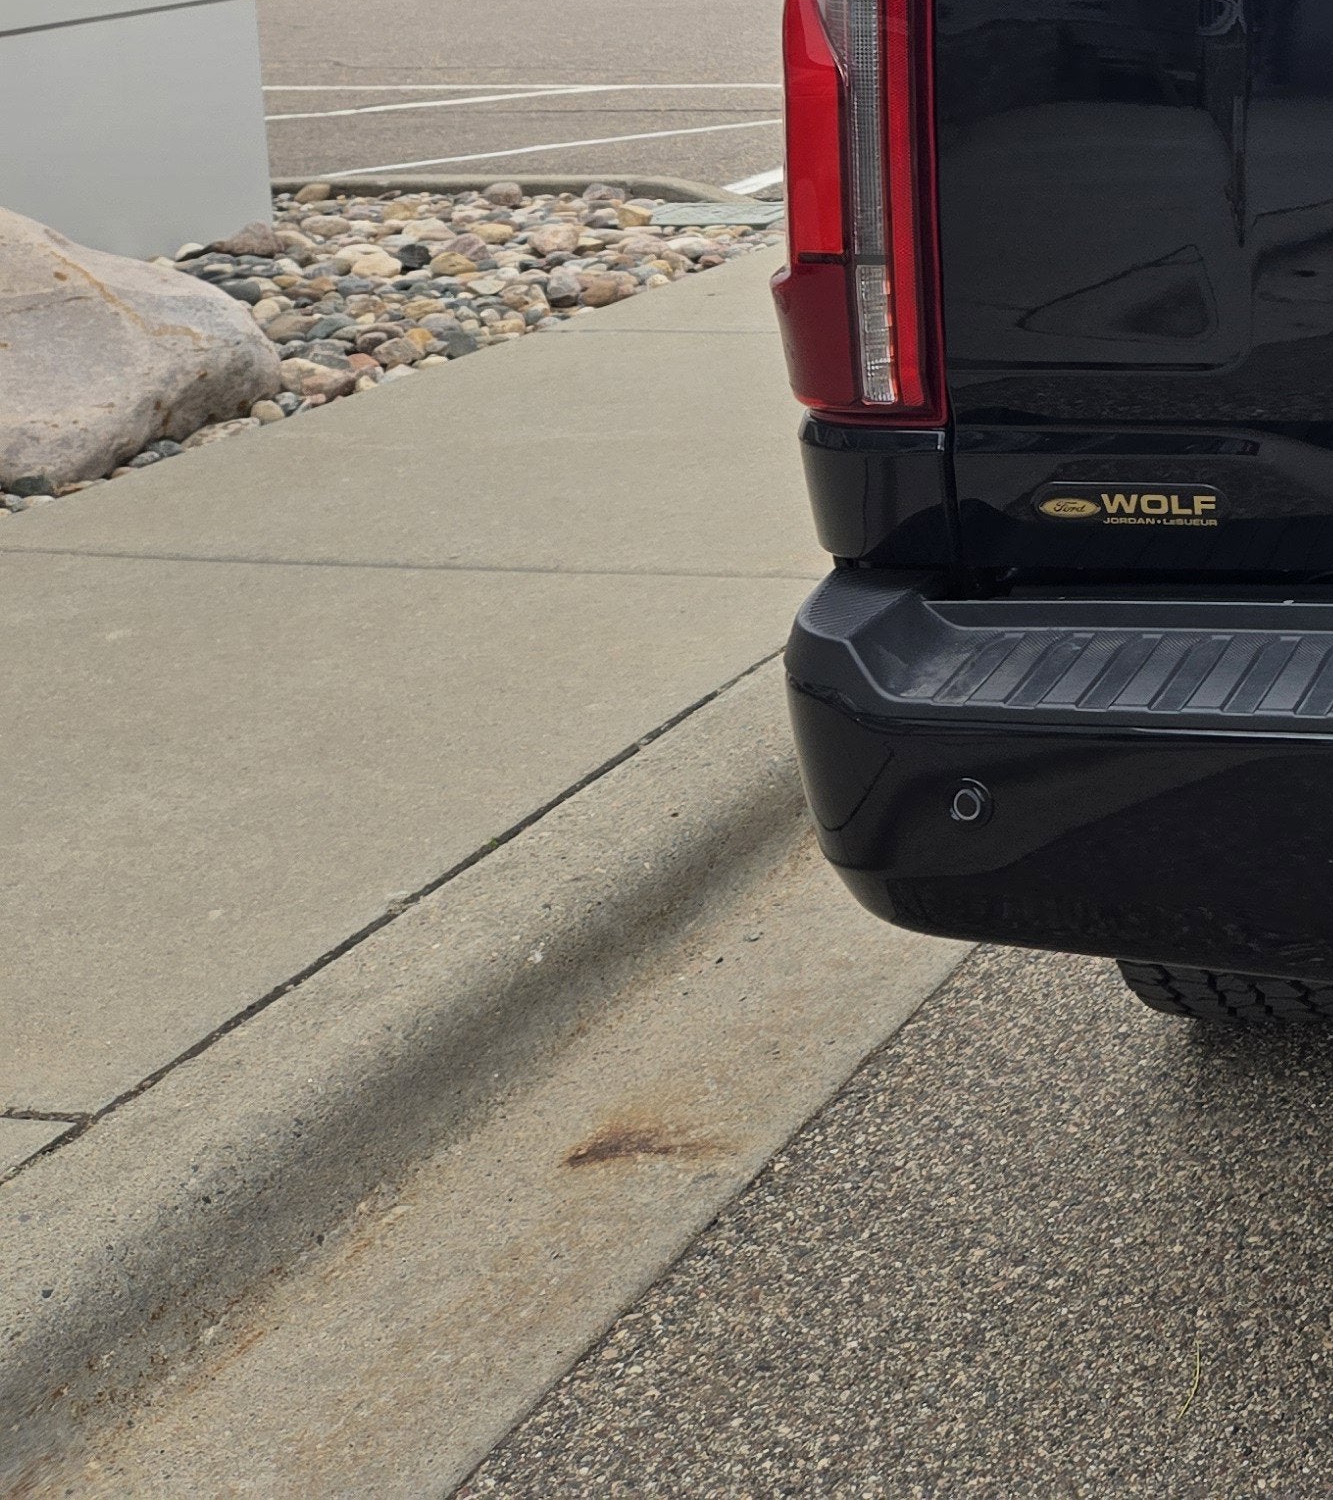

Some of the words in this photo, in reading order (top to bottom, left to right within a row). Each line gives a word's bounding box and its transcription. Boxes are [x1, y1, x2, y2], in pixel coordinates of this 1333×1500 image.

[1053, 501, 1086, 513] Ford
[1100, 493, 1217, 516] WOLF
[1103, 517, 1156, 525] JORDAN
